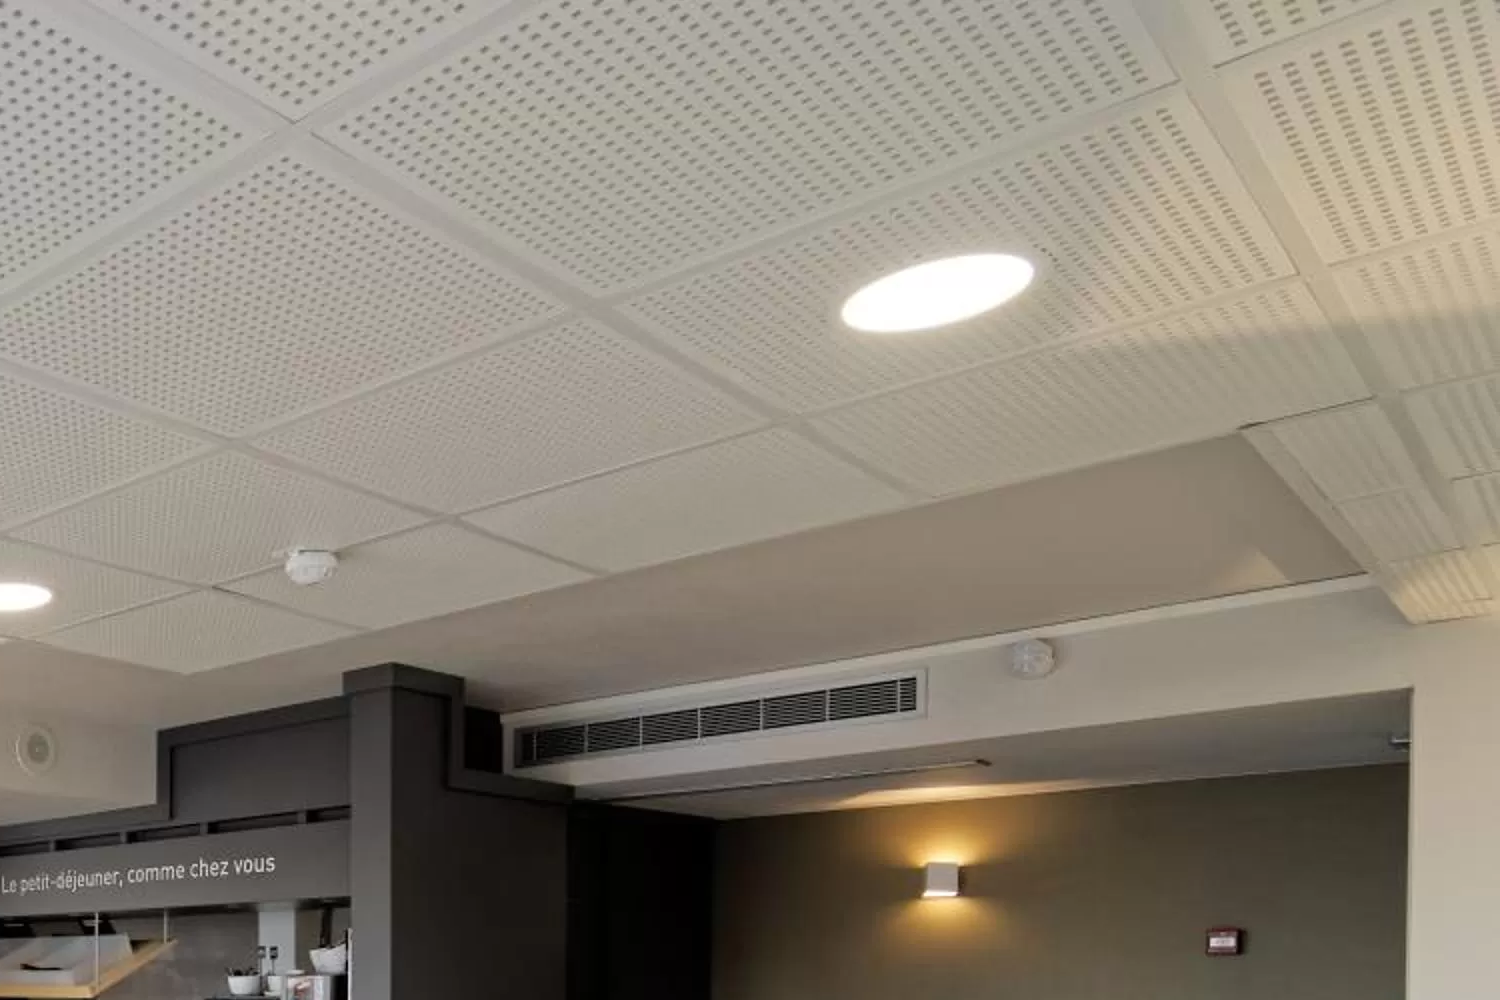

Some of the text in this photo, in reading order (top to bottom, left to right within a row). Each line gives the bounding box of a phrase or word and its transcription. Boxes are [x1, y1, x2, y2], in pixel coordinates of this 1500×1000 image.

[1, 856, 276, 896] Le petit-déjeuner, comme chez vous
